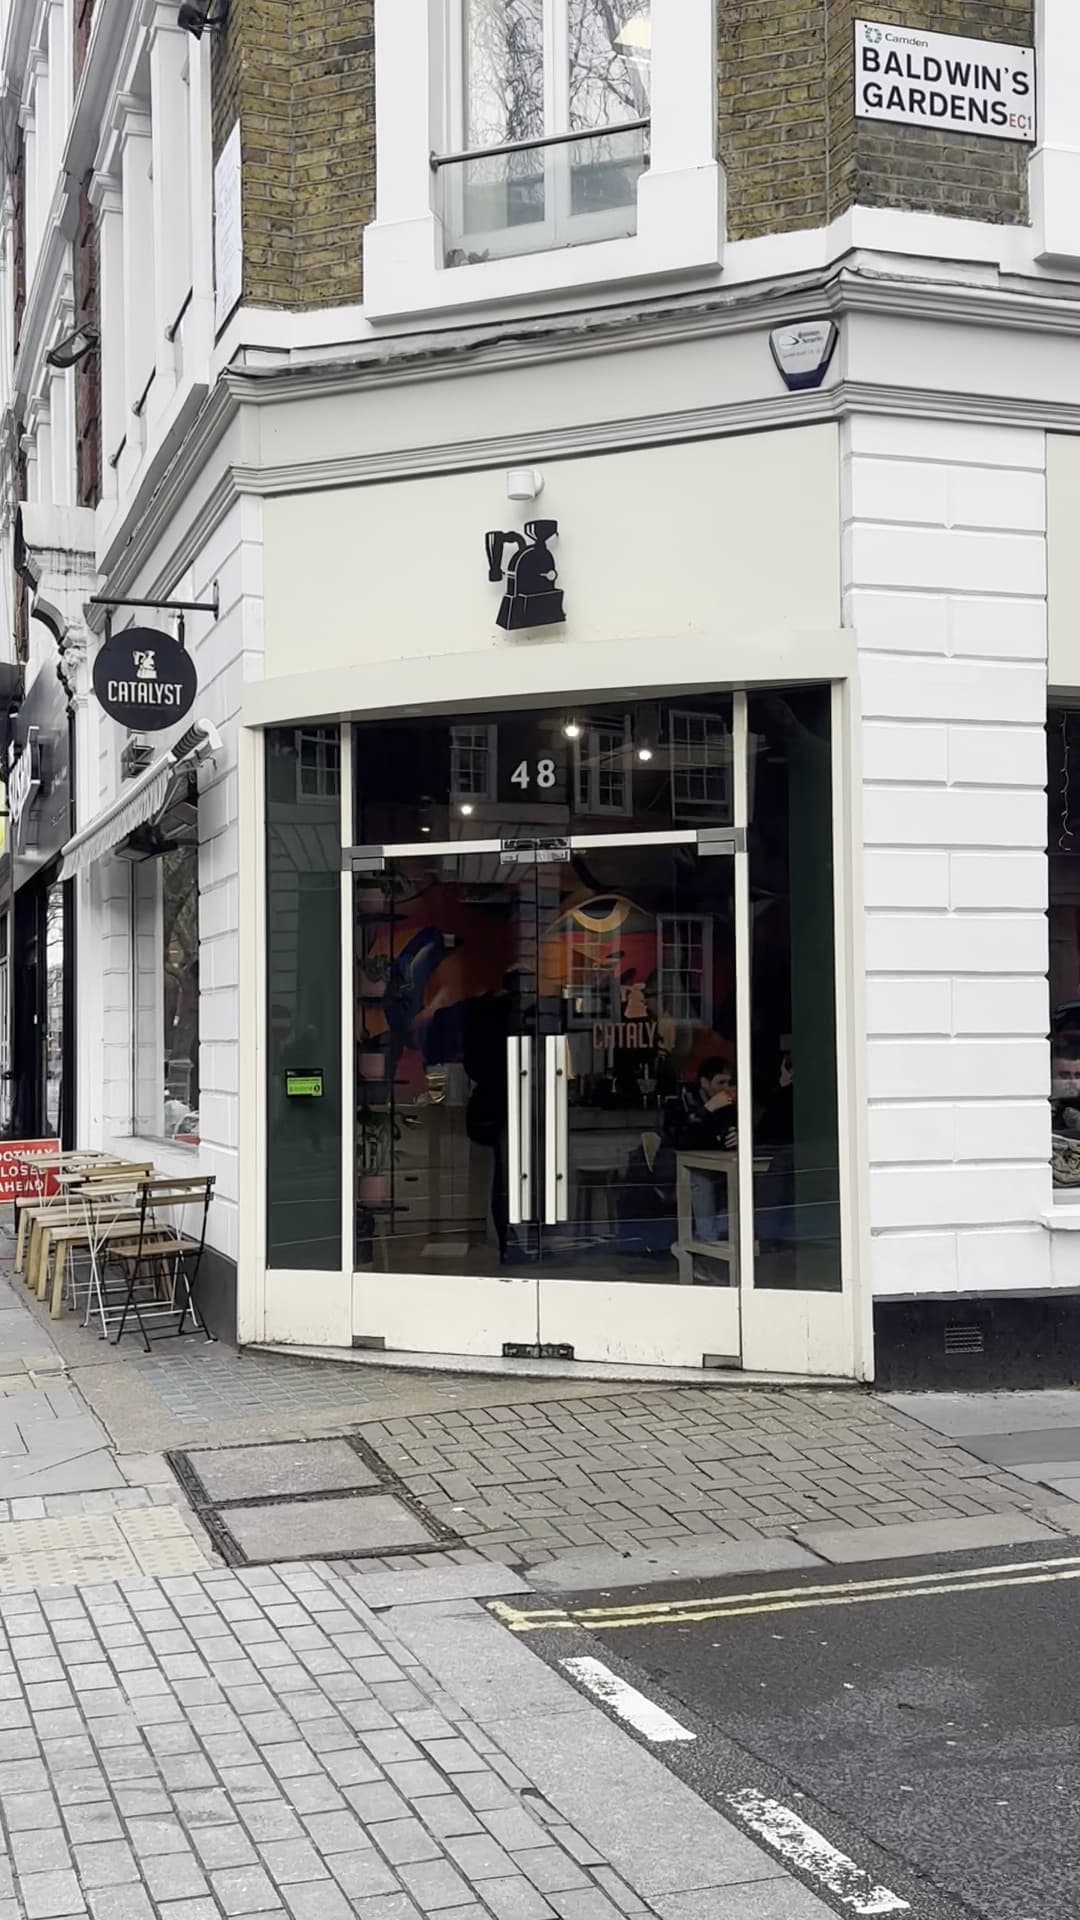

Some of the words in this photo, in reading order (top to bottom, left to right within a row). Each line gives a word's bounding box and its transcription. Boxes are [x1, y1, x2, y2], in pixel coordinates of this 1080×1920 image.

[884, 32, 929, 48] Camden
[862, 46, 1030, 96] BALDWIN'S
[862, 82, 1008, 126] GARDENS
[1009, 113, 1032, 130] EC1
[108, 680, 183, 705] CATALYST
[510, 759, 556, 789] 48
